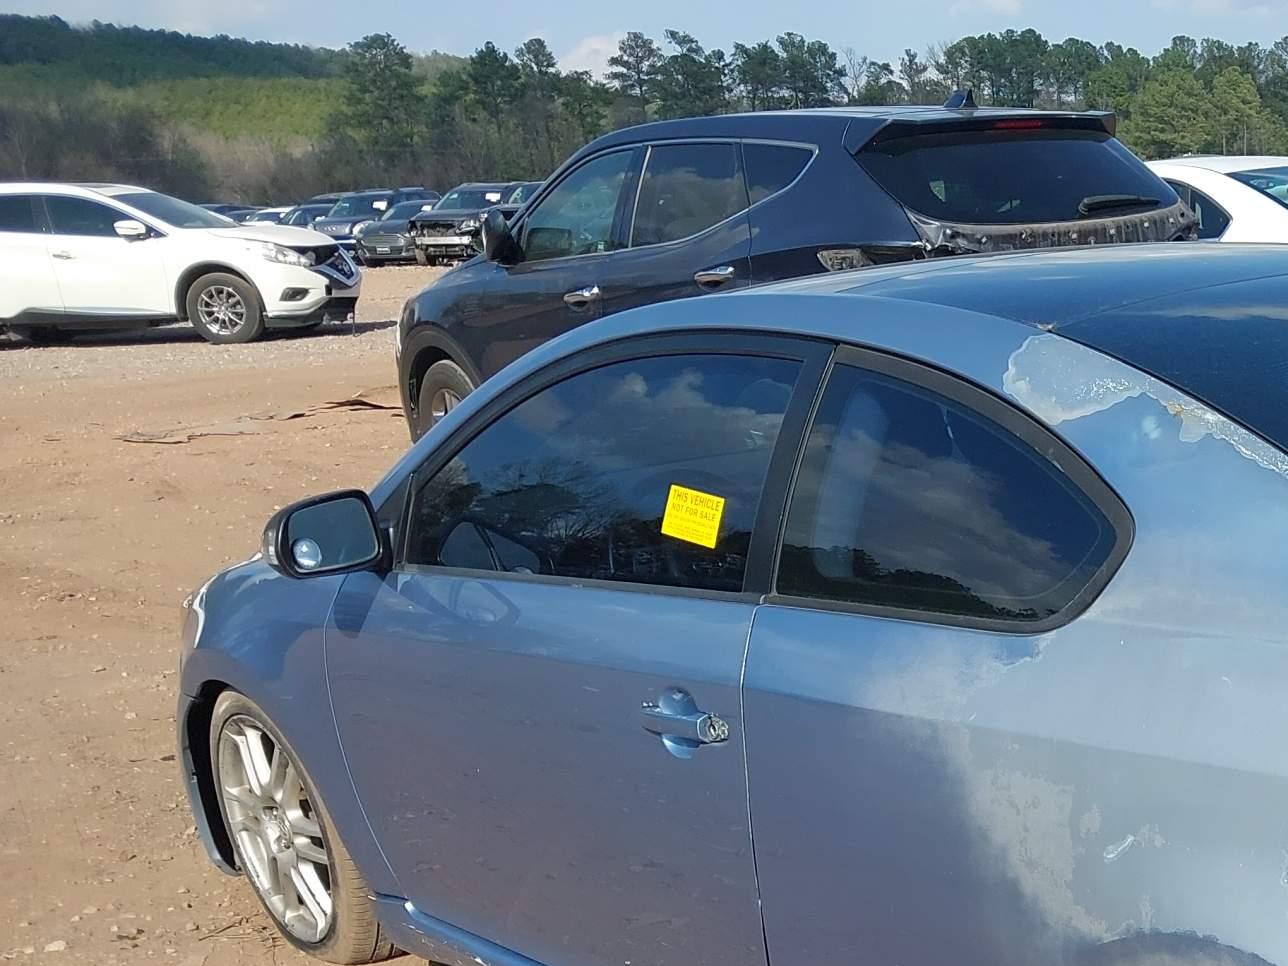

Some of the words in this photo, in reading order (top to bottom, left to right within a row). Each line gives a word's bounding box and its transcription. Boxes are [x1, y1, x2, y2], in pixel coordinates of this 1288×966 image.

[673, 489, 689, 503] THIS
[690, 494, 721, 512] VEHICLE
[672, 502, 684, 513] NOT
[686, 506, 699, 518] FOR
[699, 511, 716, 522] SALE
